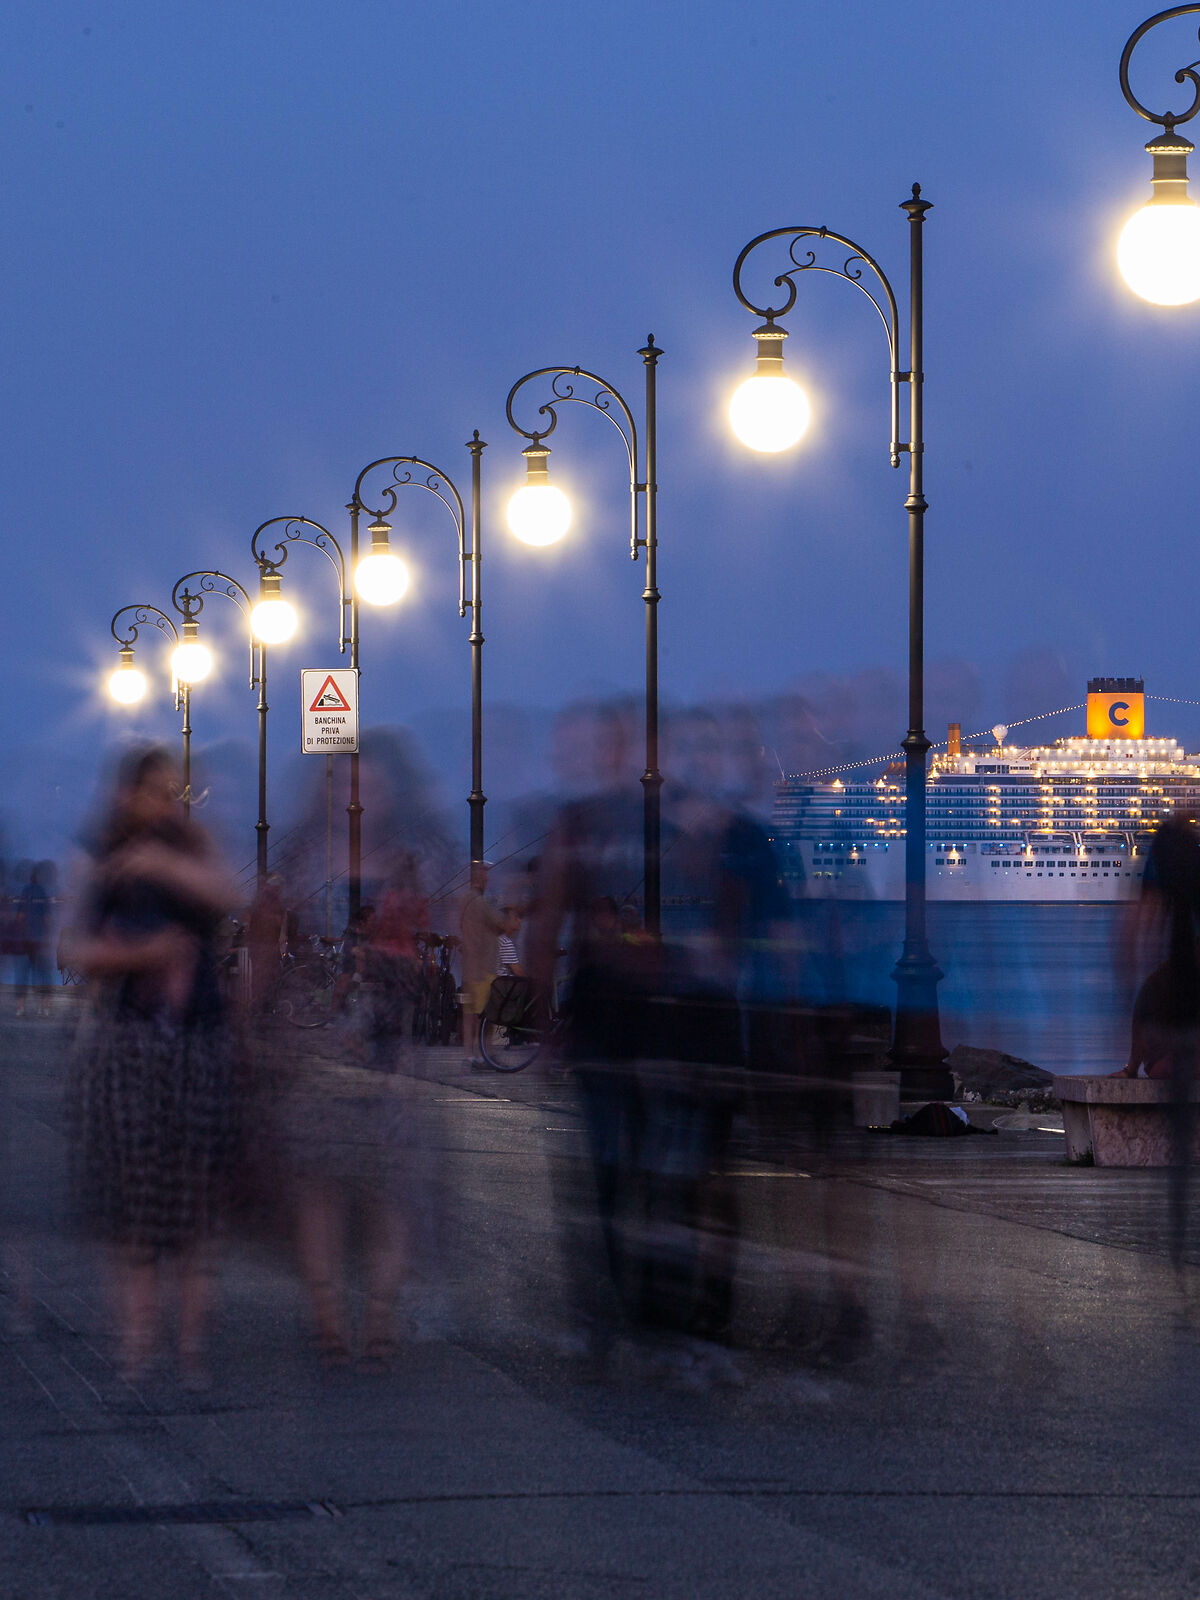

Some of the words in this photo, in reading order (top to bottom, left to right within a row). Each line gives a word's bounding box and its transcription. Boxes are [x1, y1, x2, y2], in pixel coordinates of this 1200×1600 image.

[1109, 702, 1129, 726] C
[314, 717, 347, 725] BANCHINA
[321, 727, 340, 735] PRIVA
[317, 737, 355, 745] PROTEZIONE
